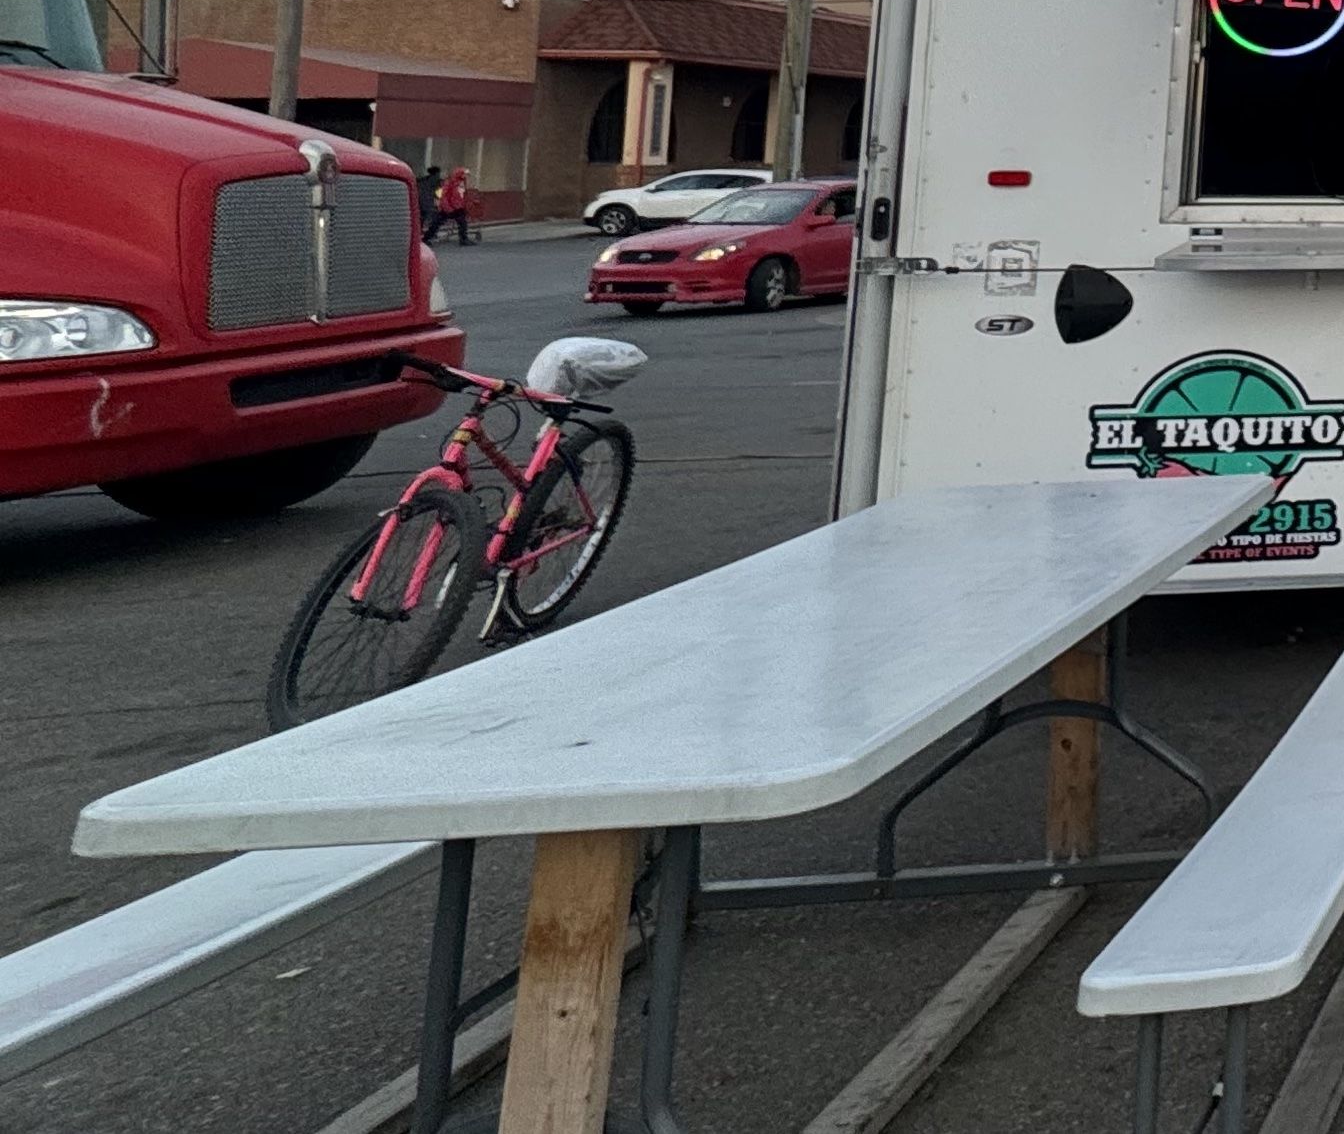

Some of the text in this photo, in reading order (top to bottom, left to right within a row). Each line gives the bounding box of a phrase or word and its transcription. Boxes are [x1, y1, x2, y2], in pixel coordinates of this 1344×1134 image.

[986, 319, 1023, 332] ST
[1094, 414, 1340, 454] EL TAQUITO
[1249, 503, 1334, 533] 2915
[1230, 534, 1263, 547] TIPO
[1265, 533, 1284, 545] DE
[1285, 531, 1337, 544] FIESTAS
[1208, 548, 1242, 560] TYPE
[1244, 547, 1264, 558] OF
[1265, 544, 1316, 557] EVENTS
